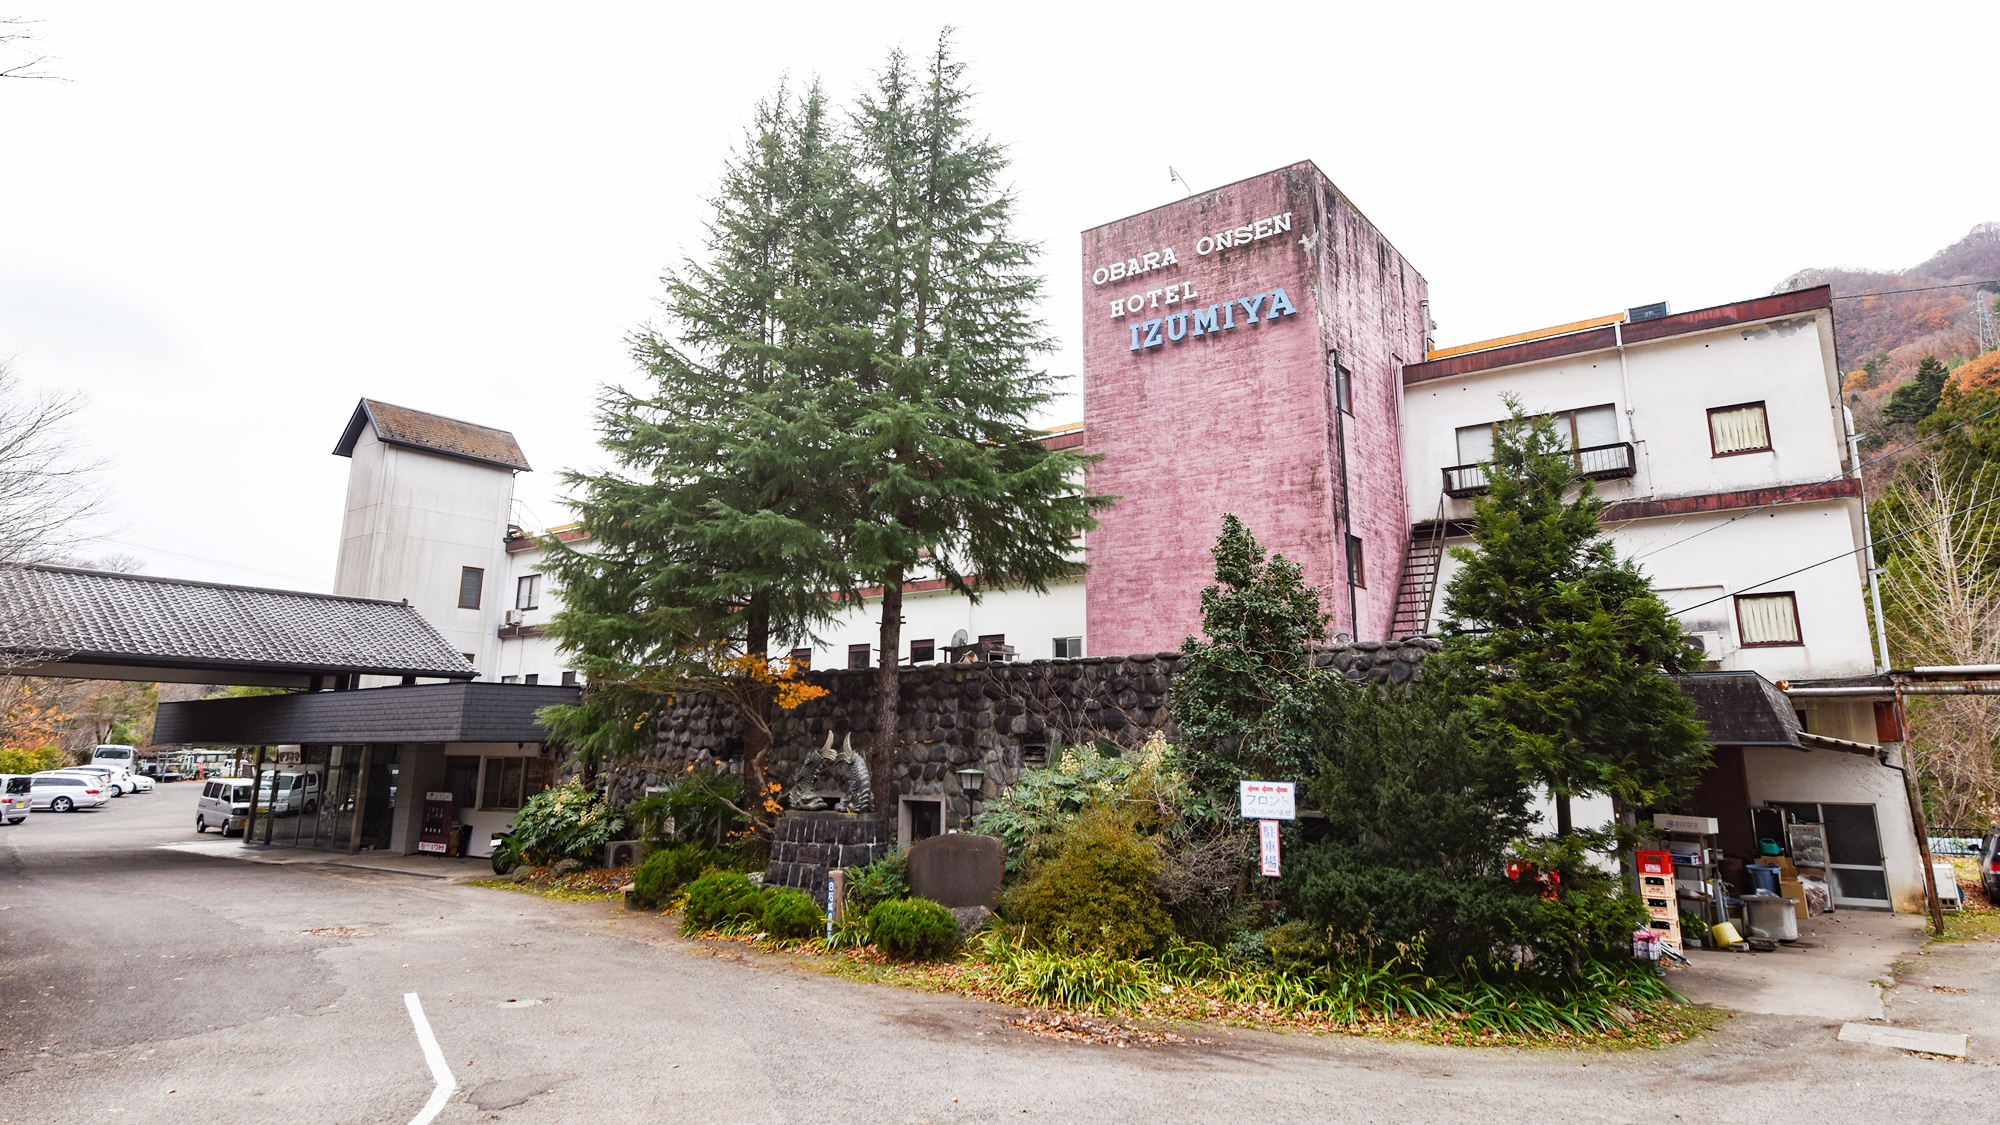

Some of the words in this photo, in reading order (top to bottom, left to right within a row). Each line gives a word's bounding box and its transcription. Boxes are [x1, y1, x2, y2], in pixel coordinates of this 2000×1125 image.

[1093, 247, 1178, 285] OBARA
[1196, 211, 1292, 256] ONSEN
[1109, 280, 1198, 319] HOTEL
[1129, 287, 1297, 351] IZUMIYA
[1246, 794, 1289, 806] フロント
[1263, 825, 1277, 869] 駐車場
